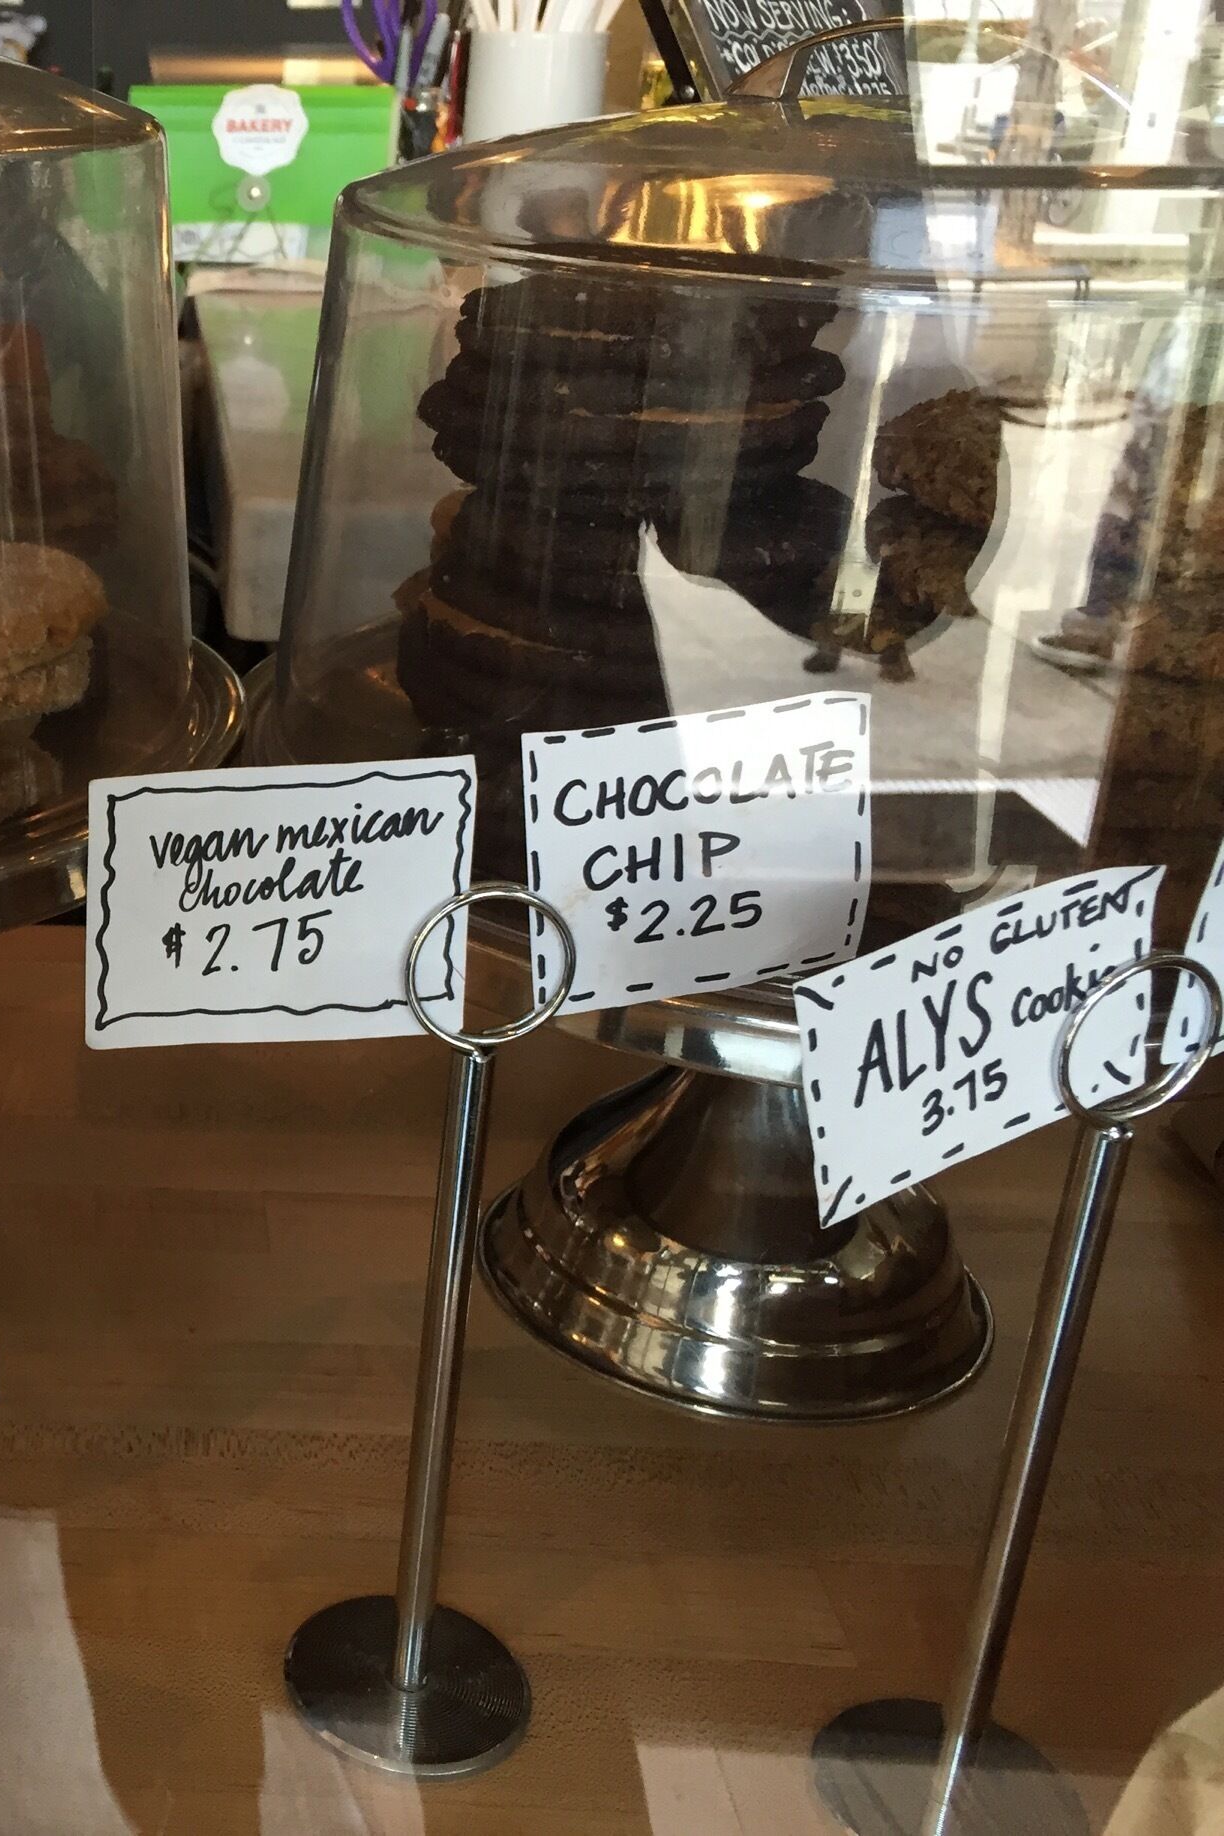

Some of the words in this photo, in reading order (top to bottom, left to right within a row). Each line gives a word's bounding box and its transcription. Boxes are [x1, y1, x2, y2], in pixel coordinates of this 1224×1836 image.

[705, 0, 758, 31] NOW
[226, 119, 292, 134] BAKERY
[554, 741, 855, 826] CHOCOLATE
[150, 826, 268, 887] vegan
[276, 803, 445, 853] mexican
[582, 831, 741, 891] CHIP
[605, 890, 763, 944] $2.25
[910, 945, 964, 983] NO
[853, 971, 994, 1108] ALYS
[921, 1058, 1008, 1137] 3.75
